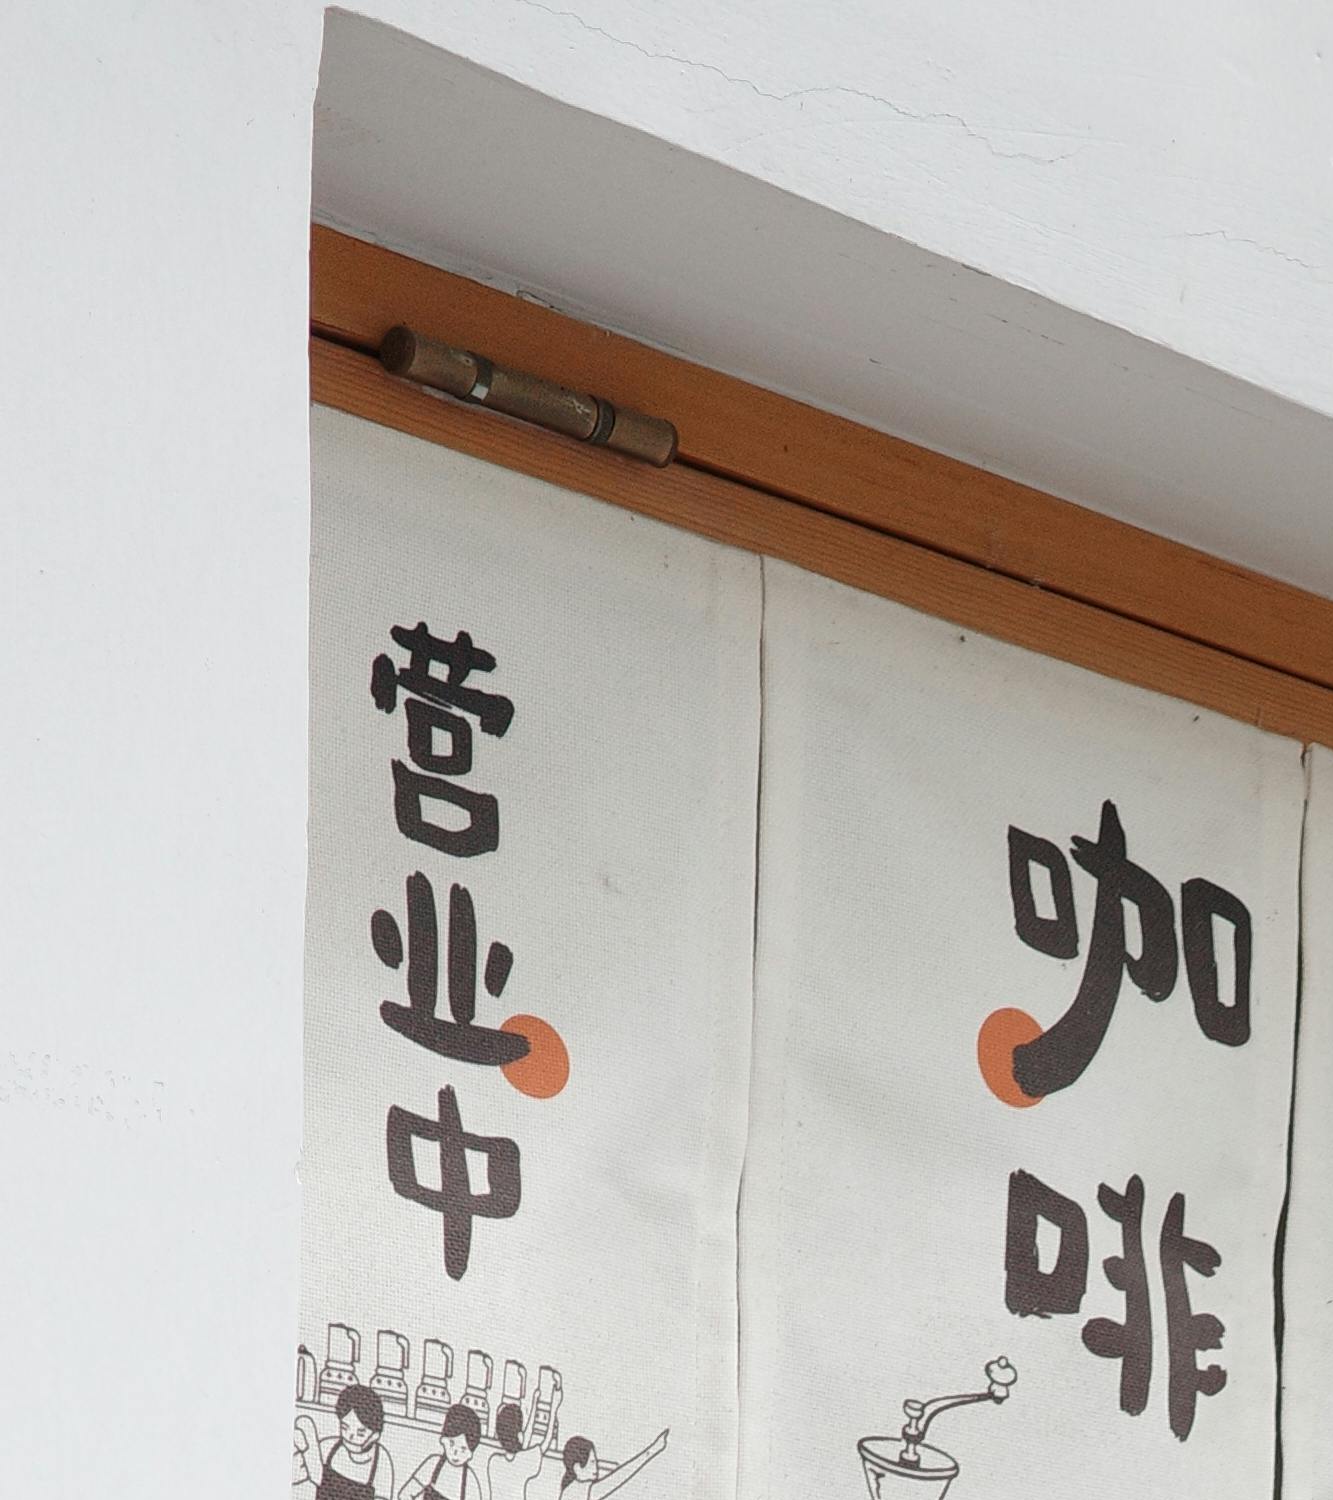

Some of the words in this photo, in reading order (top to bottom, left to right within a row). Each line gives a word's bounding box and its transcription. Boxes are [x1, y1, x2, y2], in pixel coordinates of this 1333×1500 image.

[371, 622, 530, 1280] 营业中
[1005, 800, 1252, 1437] 咖啡
